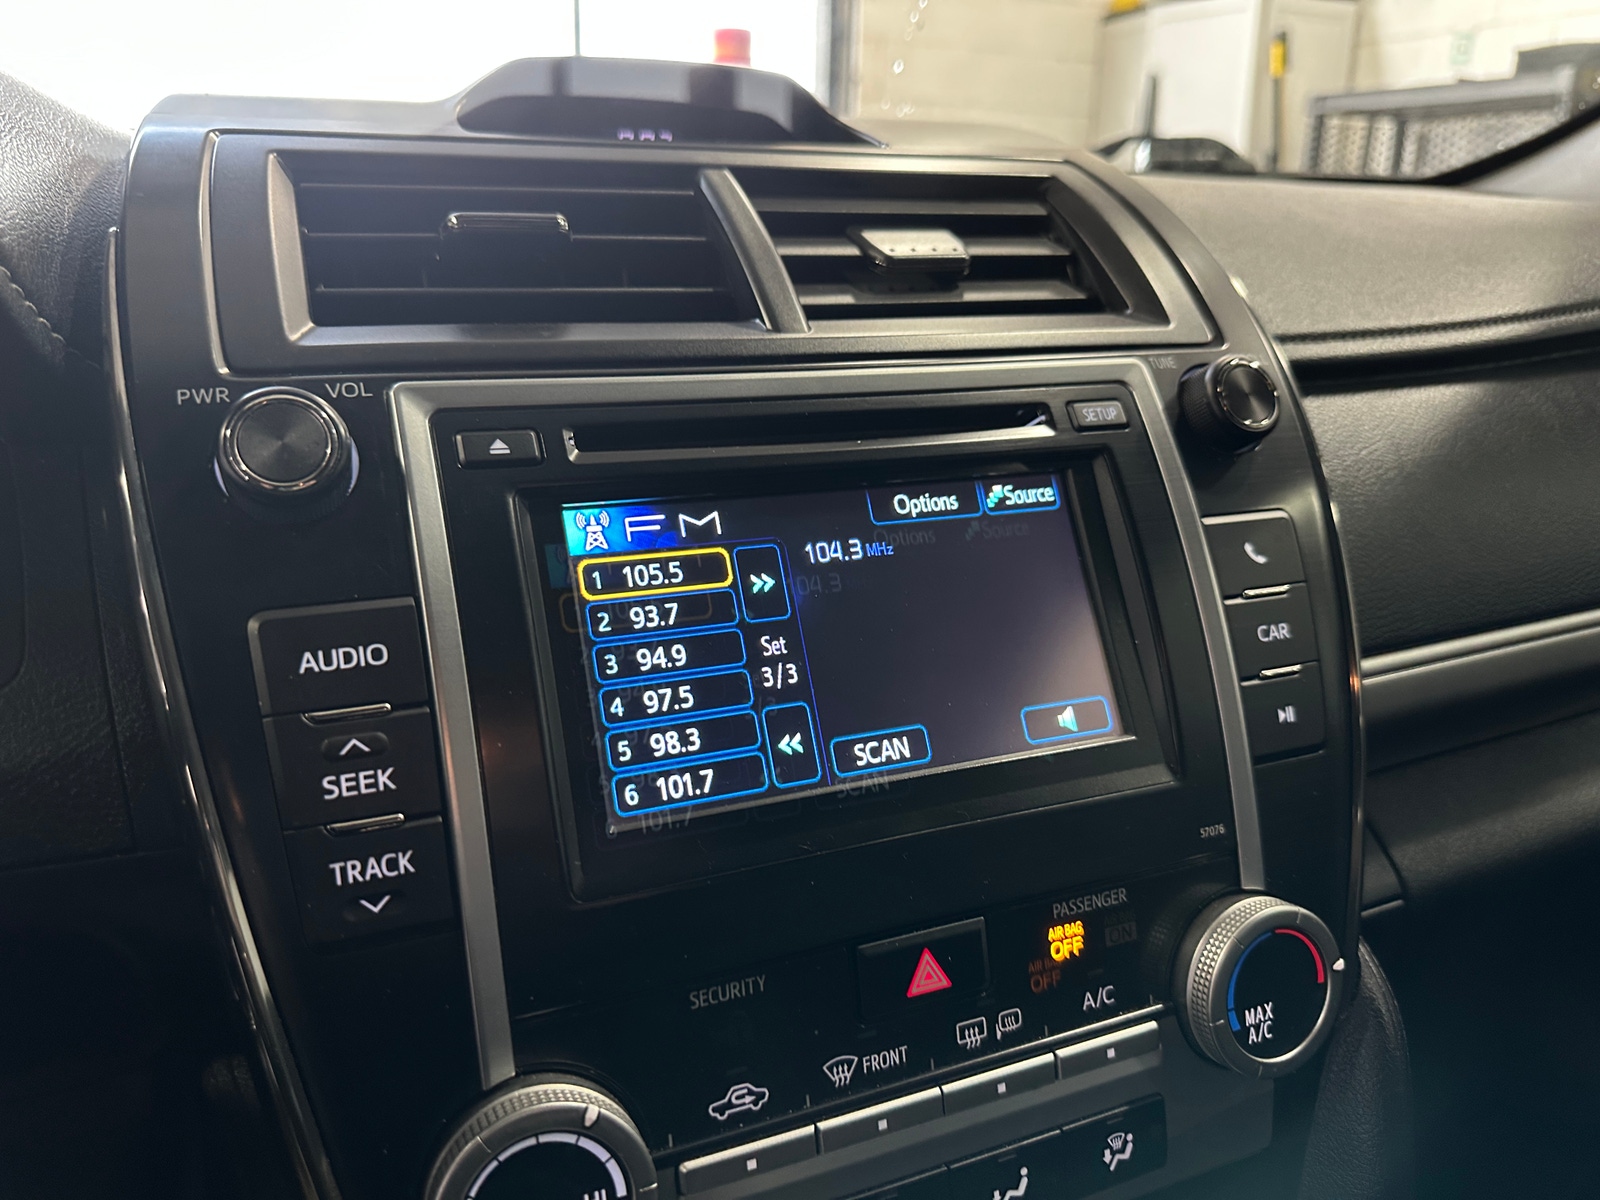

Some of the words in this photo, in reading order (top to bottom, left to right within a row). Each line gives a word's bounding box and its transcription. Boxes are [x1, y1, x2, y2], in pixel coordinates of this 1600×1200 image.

[1149, 356, 1177, 370] TUNE
[177, 386, 230, 405] PWR
[325, 381, 373, 399] VOL
[1081, 406, 1118, 422] SETUP
[892, 491, 959, 517] Options
[1003, 483, 1056, 505] Source
[624, 510, 723, 542] FM
[804, 537, 863, 565] 104.3
[865, 541, 894, 558] MHz
[591, 570, 603, 590] 1
[622, 561, 684, 588] 105.5
[597, 611, 612, 633] 2
[629, 602, 679, 630] 93.7
[760, 635, 788, 656] Set
[1256, 622, 1292, 643] CAR
[299, 643, 389, 675] AUDIO
[604, 654, 619, 675] 3
[636, 643, 687, 672] 94.9
[761, 663, 798, 690] 3/3
[610, 697, 625, 718] 4
[643, 685, 695, 714] 97.5
[617, 740, 632, 762] 5
[649, 727, 702, 758] 98.3
[853, 735, 911, 767] SCAN
[321, 767, 398, 800] SEEK
[624, 784, 640, 806] 6
[656, 768, 715, 802] 101.7
[1200, 823, 1225, 838] 57076
[328, 850, 416, 886] TRACK
[1052, 887, 1127, 919] PASSENGER
[1048, 925, 1065, 942] AIR
[1063, 920, 1085, 938] BAG
[1109, 923, 1133, 943] ON
[1050, 935, 1085, 963] OFF
[690, 974, 766, 1010] SECURITY
[1082, 985, 1116, 1011] A/C
[1244, 1001, 1275, 1027] MAX
[1248, 1020, 1274, 1045] A/C
[862, 1045, 908, 1075] FRONT
